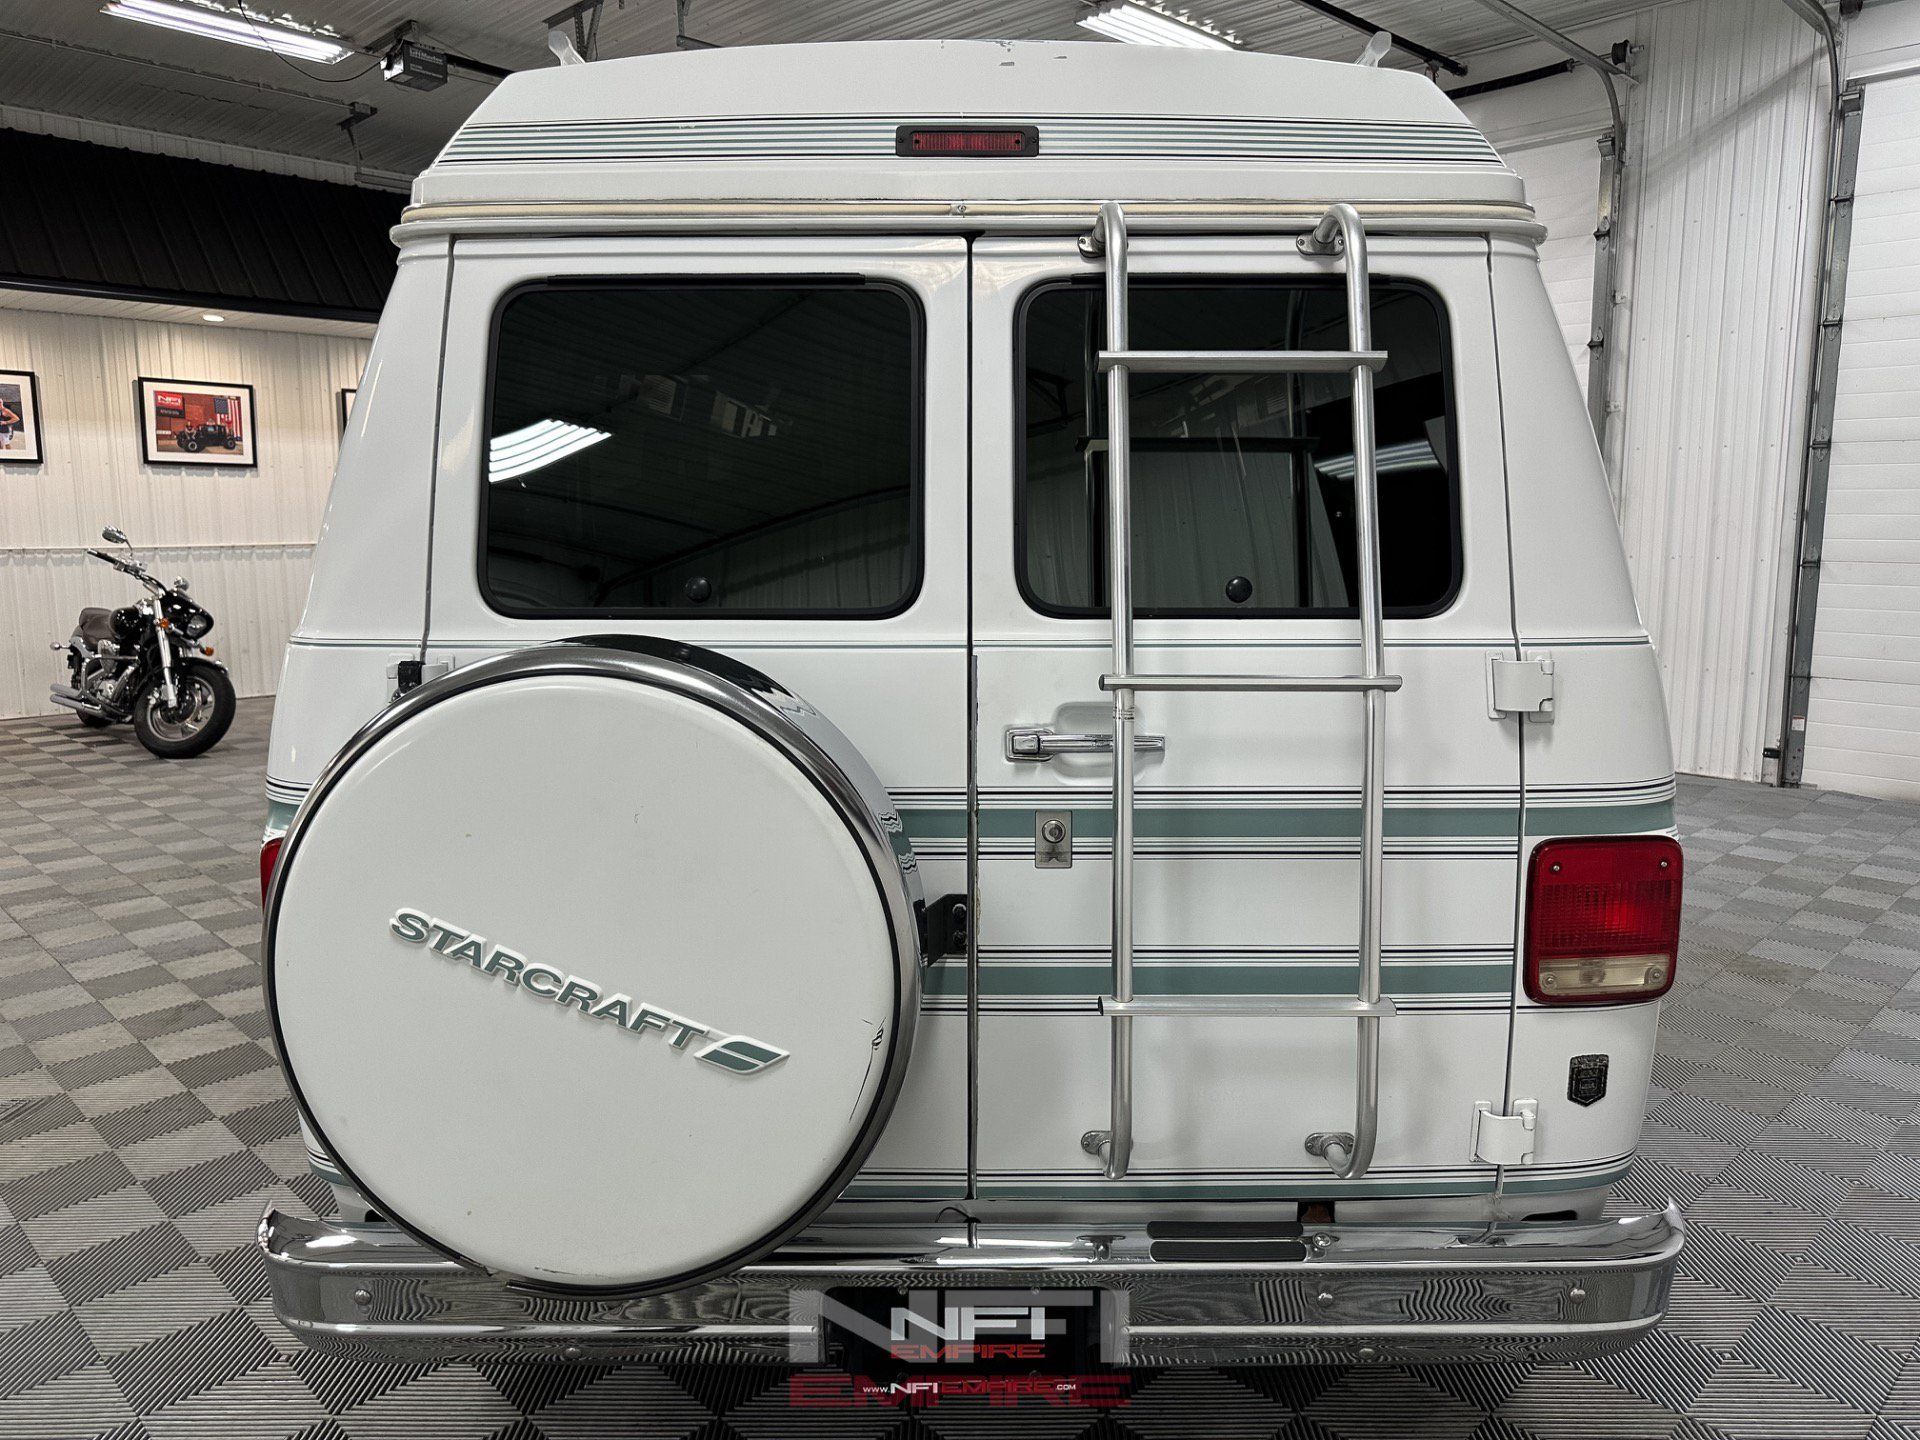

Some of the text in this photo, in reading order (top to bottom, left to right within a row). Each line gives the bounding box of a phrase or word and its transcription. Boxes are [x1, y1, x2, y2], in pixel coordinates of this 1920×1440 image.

[389, 907, 710, 1051] STARCRAFT
[891, 1307, 1045, 1340] NFI
[890, 1344, 1045, 1359] EMPIRE
